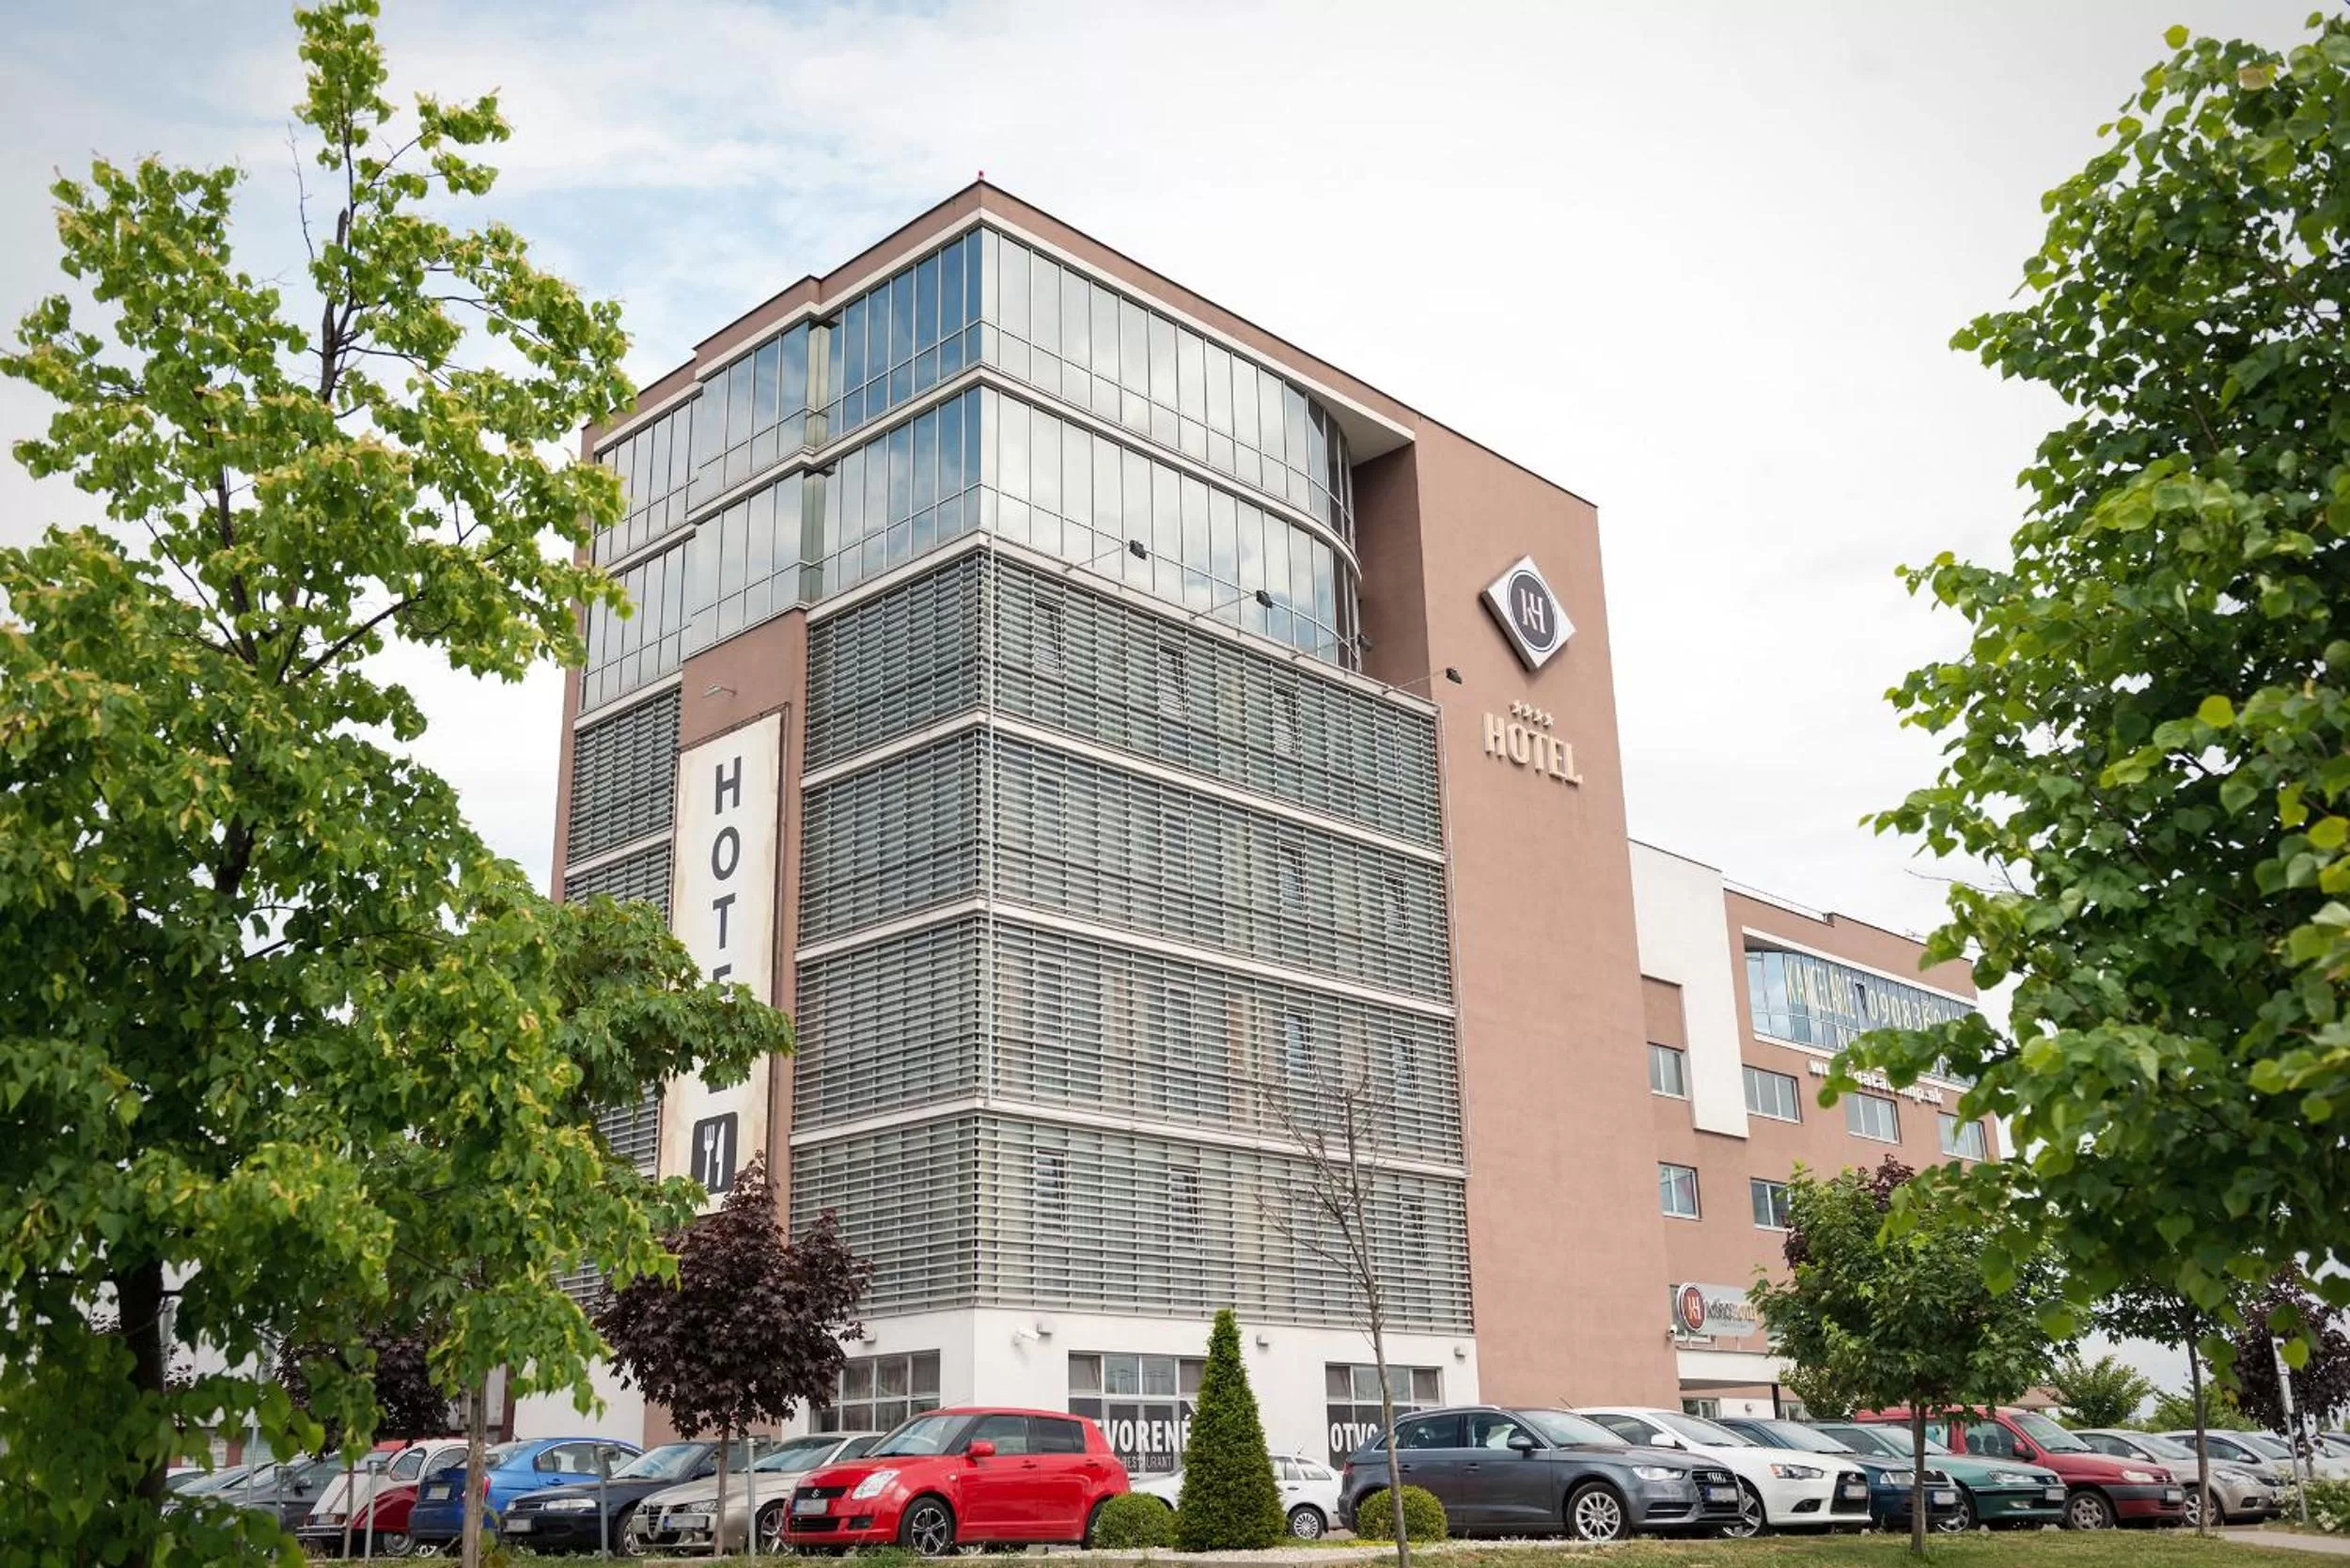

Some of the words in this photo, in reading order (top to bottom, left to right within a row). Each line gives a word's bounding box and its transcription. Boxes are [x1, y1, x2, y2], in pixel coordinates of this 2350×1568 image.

[1481, 712, 1583, 784] HOTEL
[708, 755, 742, 1094] HOT
[1094, 1414, 1192, 1453] VORENÉ
